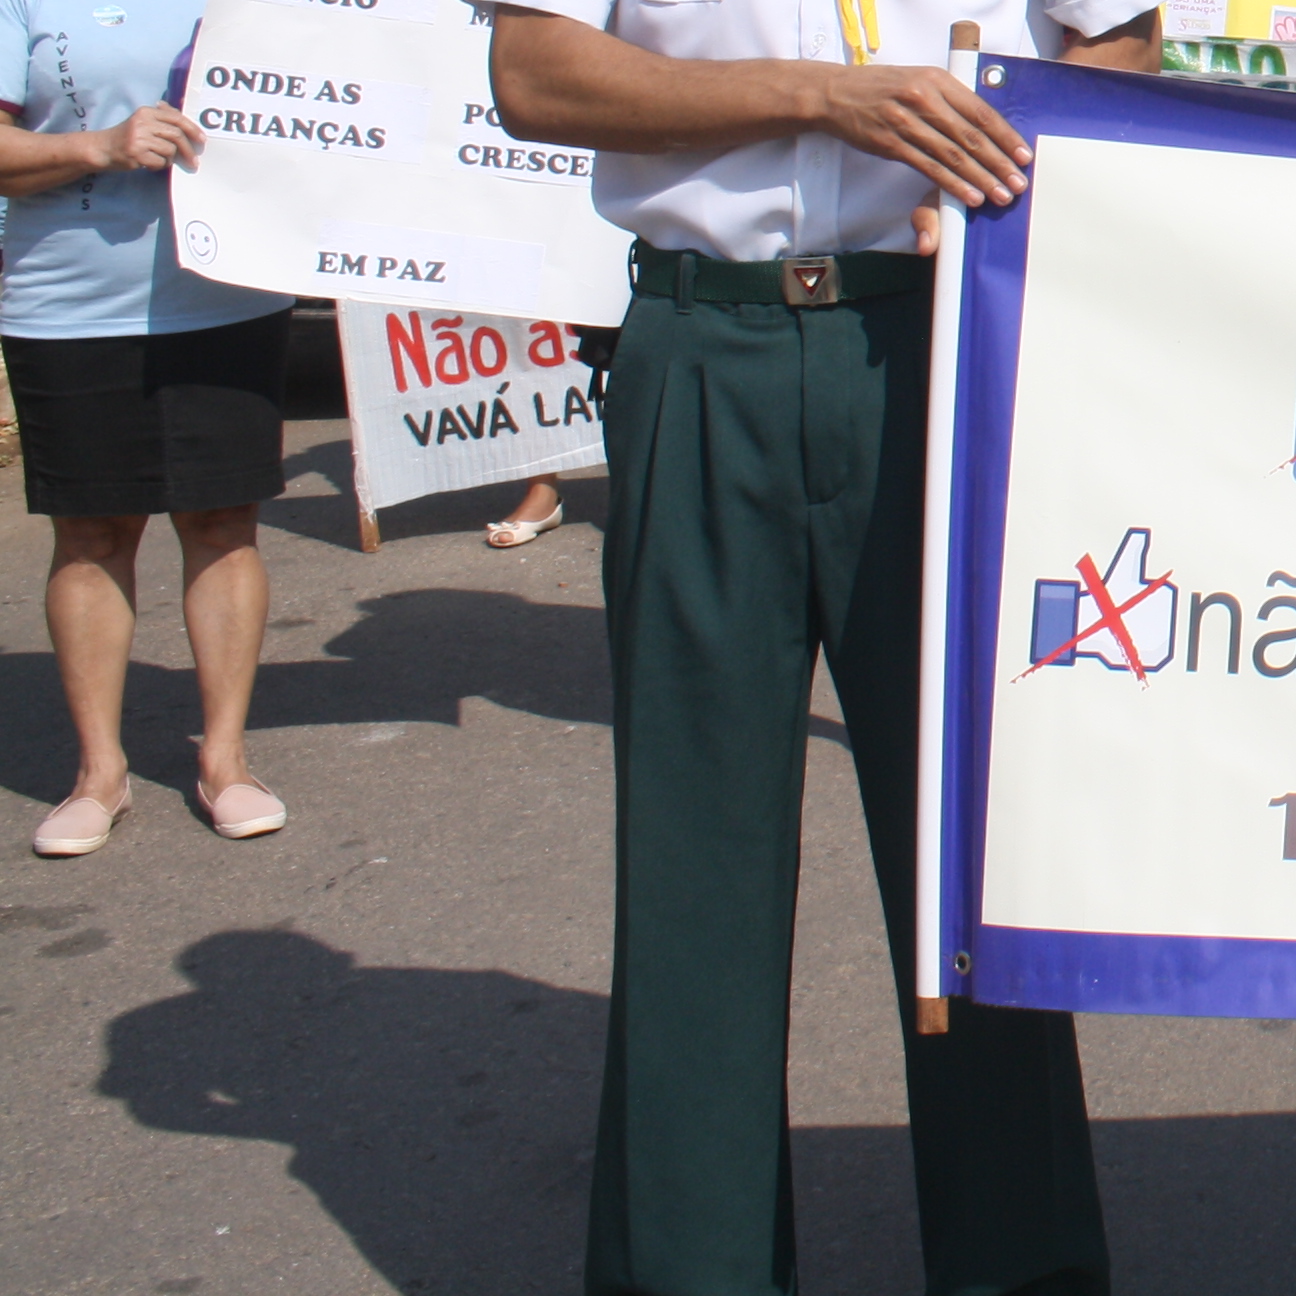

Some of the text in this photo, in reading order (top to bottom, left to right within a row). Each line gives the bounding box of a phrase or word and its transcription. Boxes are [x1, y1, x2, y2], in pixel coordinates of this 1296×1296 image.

[206, 66, 362, 104] ONDE AS
[199, 108, 386, 150] CRIANÇAS
[458, 143, 596, 177] CRESCE
[316, 251, 446, 283] EM PAZ
[386, 310, 508, 393] Não
[404, 381, 520, 446] VAVÁ
